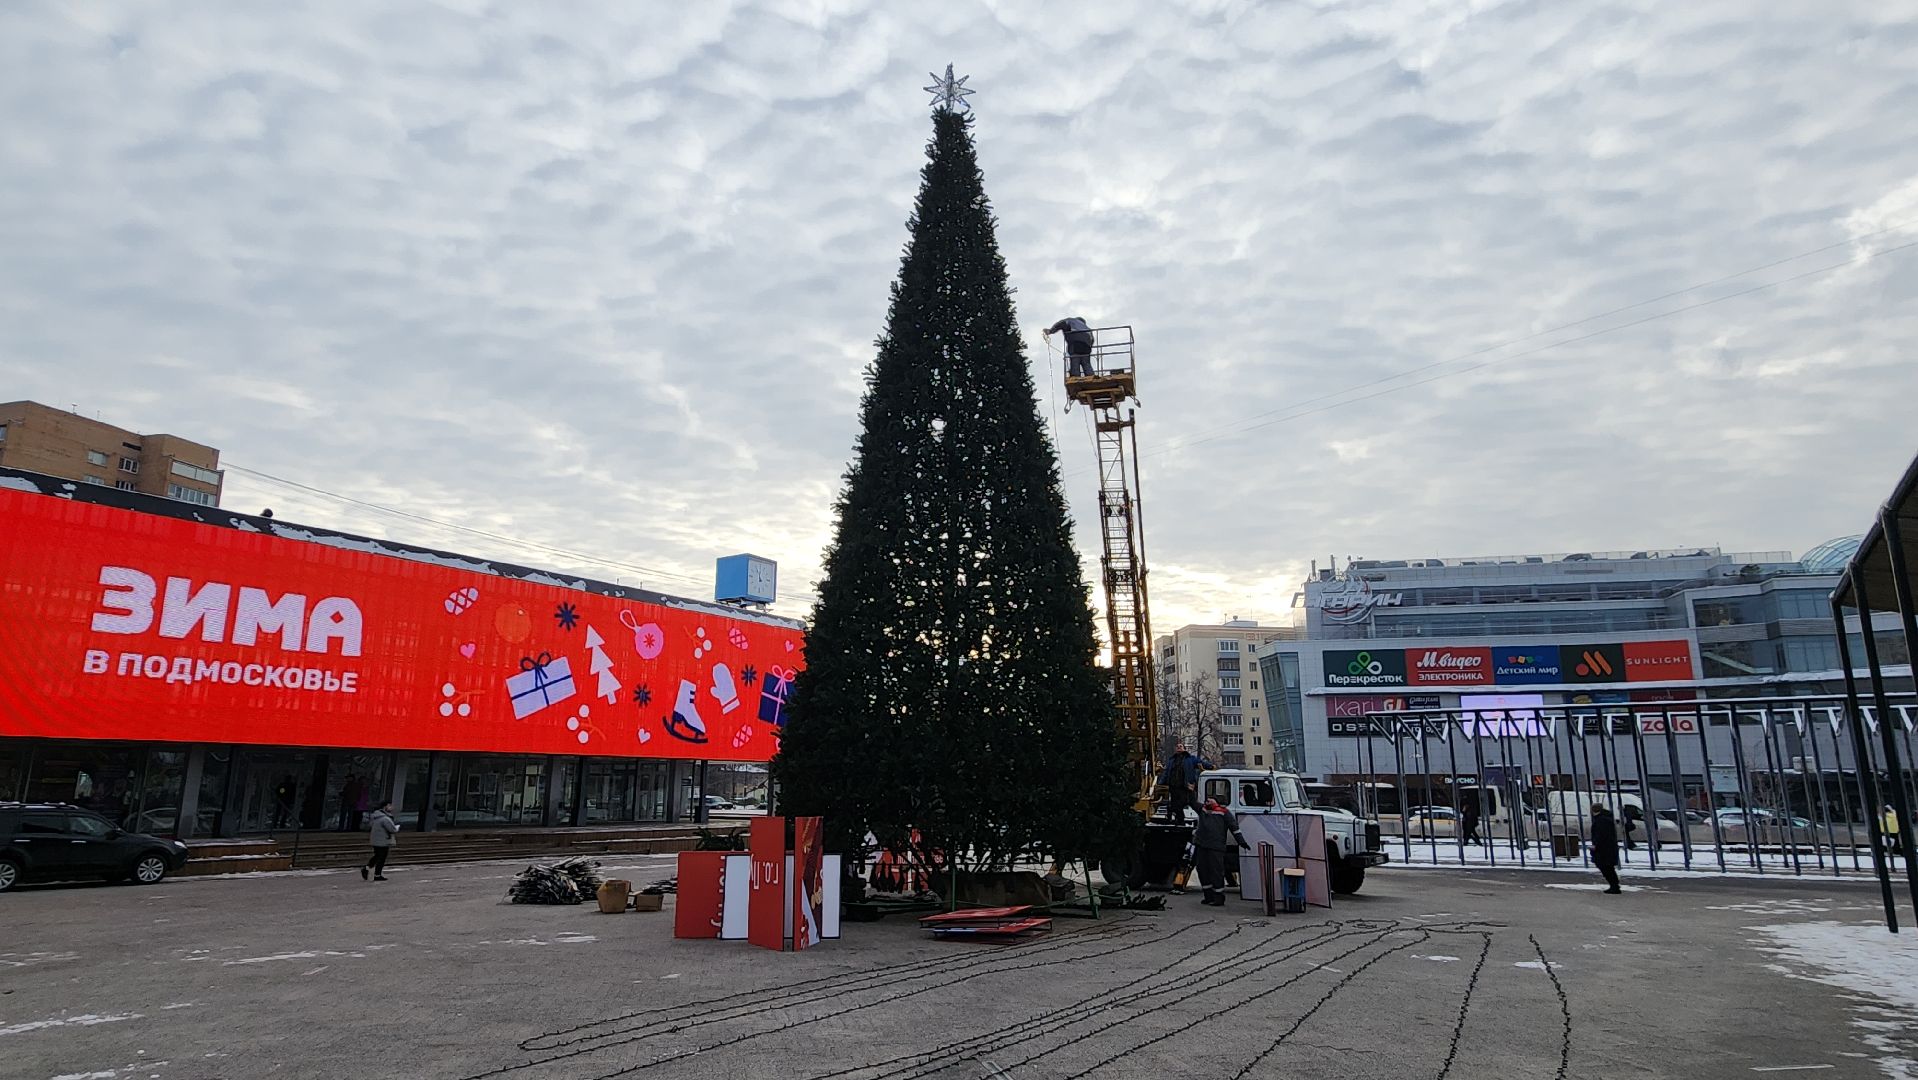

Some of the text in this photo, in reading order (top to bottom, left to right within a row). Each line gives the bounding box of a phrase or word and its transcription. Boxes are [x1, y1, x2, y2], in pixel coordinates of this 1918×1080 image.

[91, 565, 363, 657] ЗИМА
[1625, 656, 1688, 665] SUNLIGHT
[1496, 665, 1559, 675] Детский мир
[1328, 674, 1404, 685] Перекресток
[1418, 673, 1484, 681] ЭЛЕКТРОНИКА
[1334, 696, 1374, 715] kari
[1641, 716, 1693, 731] zola
